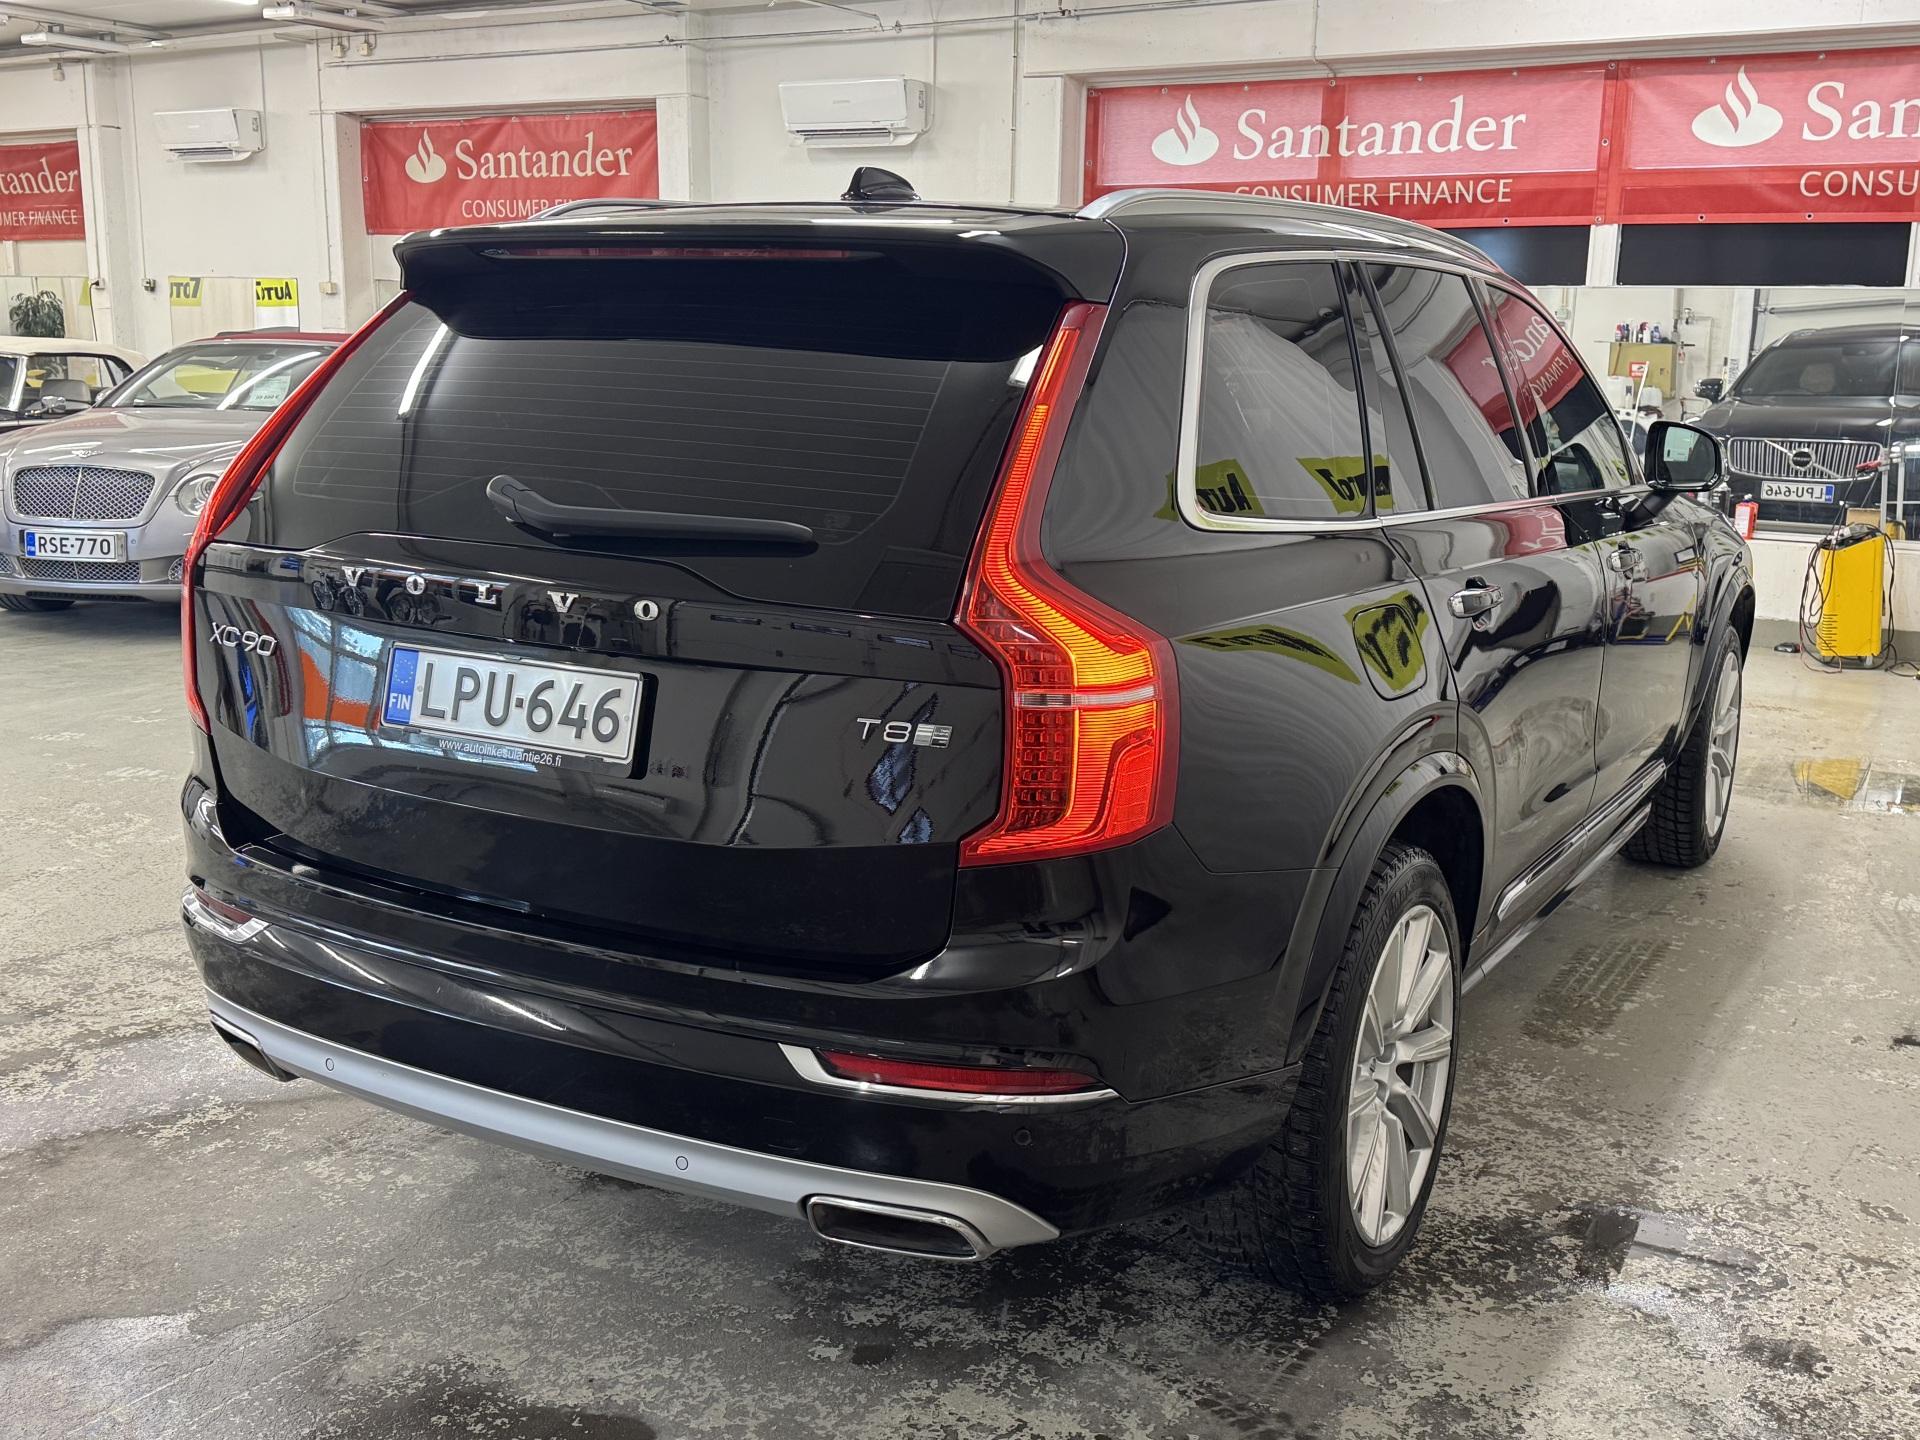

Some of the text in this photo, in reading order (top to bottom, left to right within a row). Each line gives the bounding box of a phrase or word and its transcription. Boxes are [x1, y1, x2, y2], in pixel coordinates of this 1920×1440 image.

[1233, 94, 1527, 160] Santander
[455, 131, 632, 180] Santander
[1389, 179, 1513, 206] FINANCE
[1800, 169, 1920, 197] CONSU
[29, 209, 78, 225] FINANCE
[38, 536, 111, 555] RSE-770
[341, 566, 659, 621] VOLVO
[209, 622, 278, 656] XC90
[389, 693, 411, 711] FIN
[420, 662, 622, 743] LPU-646
[857, 718, 912, 742] T8
